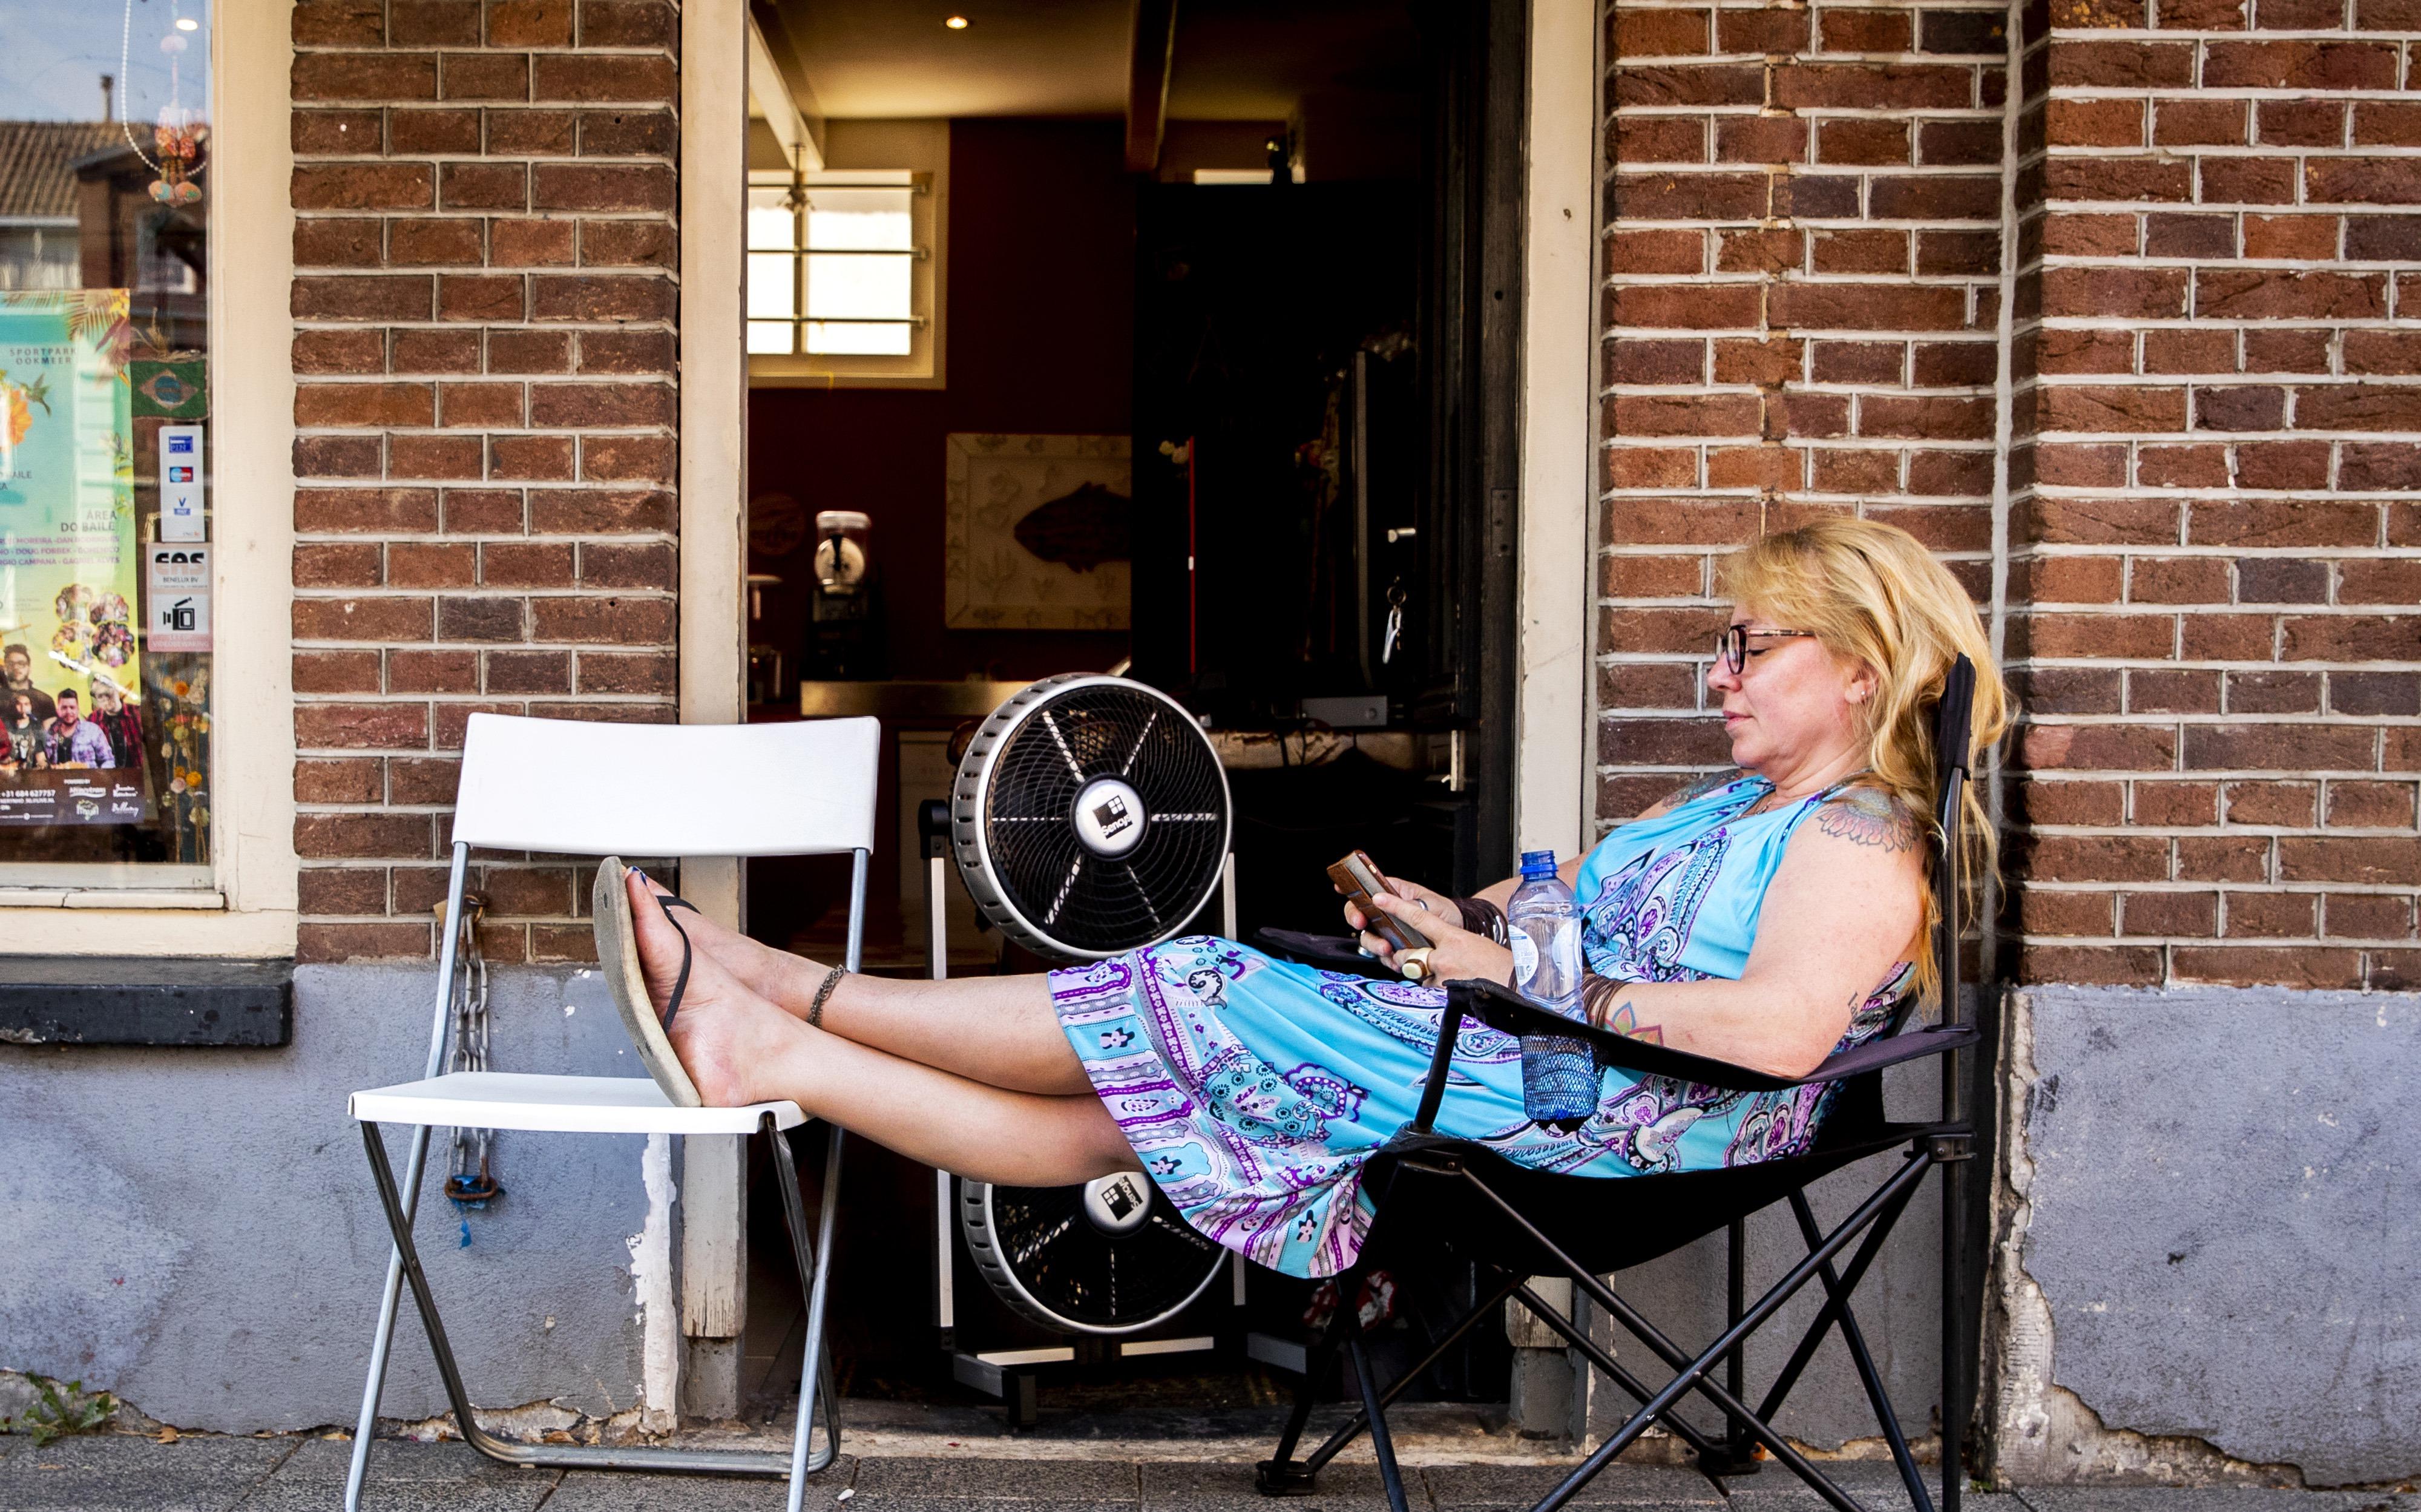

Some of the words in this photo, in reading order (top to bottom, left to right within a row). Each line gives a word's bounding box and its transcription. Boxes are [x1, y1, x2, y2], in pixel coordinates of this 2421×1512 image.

[87, 508, 117, 521] ÁREA
[61, 522, 78, 532] DO
[82, 521, 116, 531] BAILE
[155, 551, 205, 576] EAS
